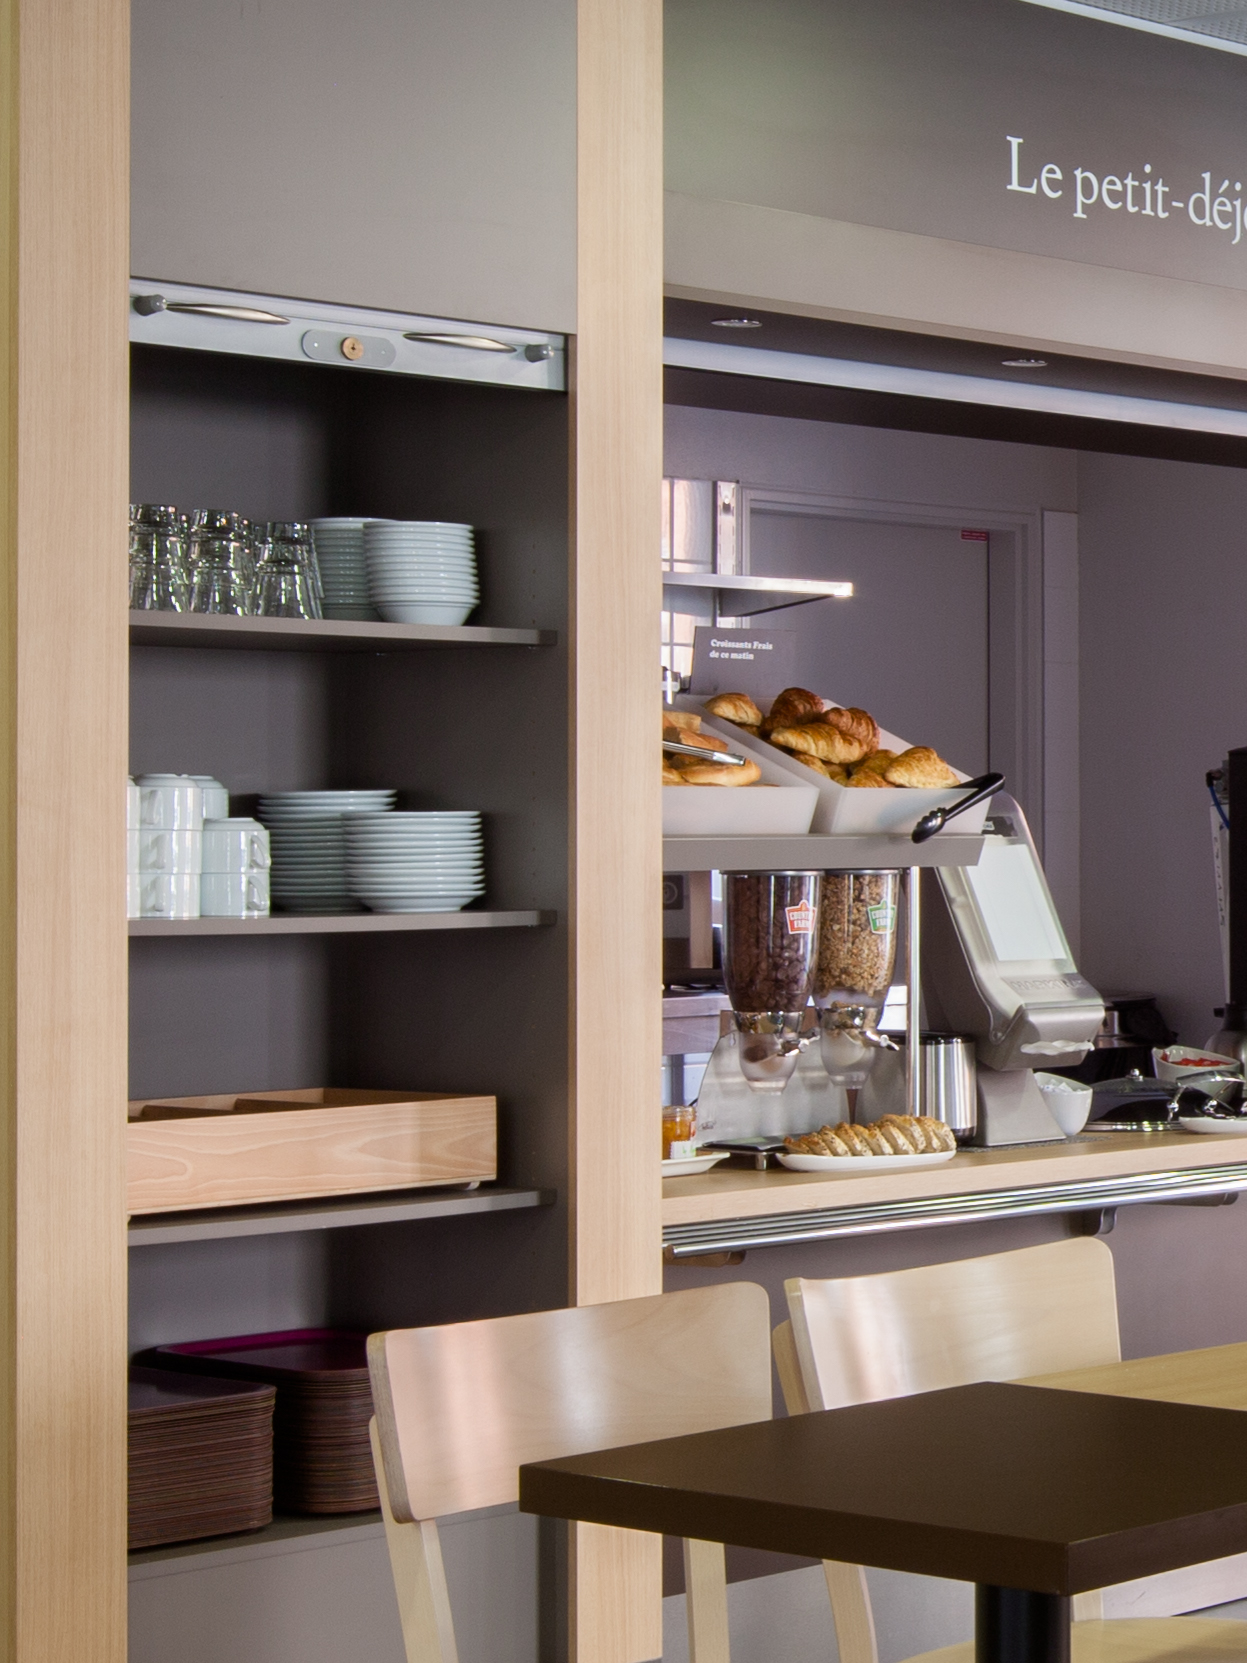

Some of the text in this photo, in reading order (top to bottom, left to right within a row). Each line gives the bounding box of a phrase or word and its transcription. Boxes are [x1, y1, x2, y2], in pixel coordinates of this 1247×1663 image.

[1006, 136, 1062, 198] Le
[710, 639, 773, 651] Croissants Frais
[709, 650, 719, 659] de
[730, 652, 754, 660] matin
